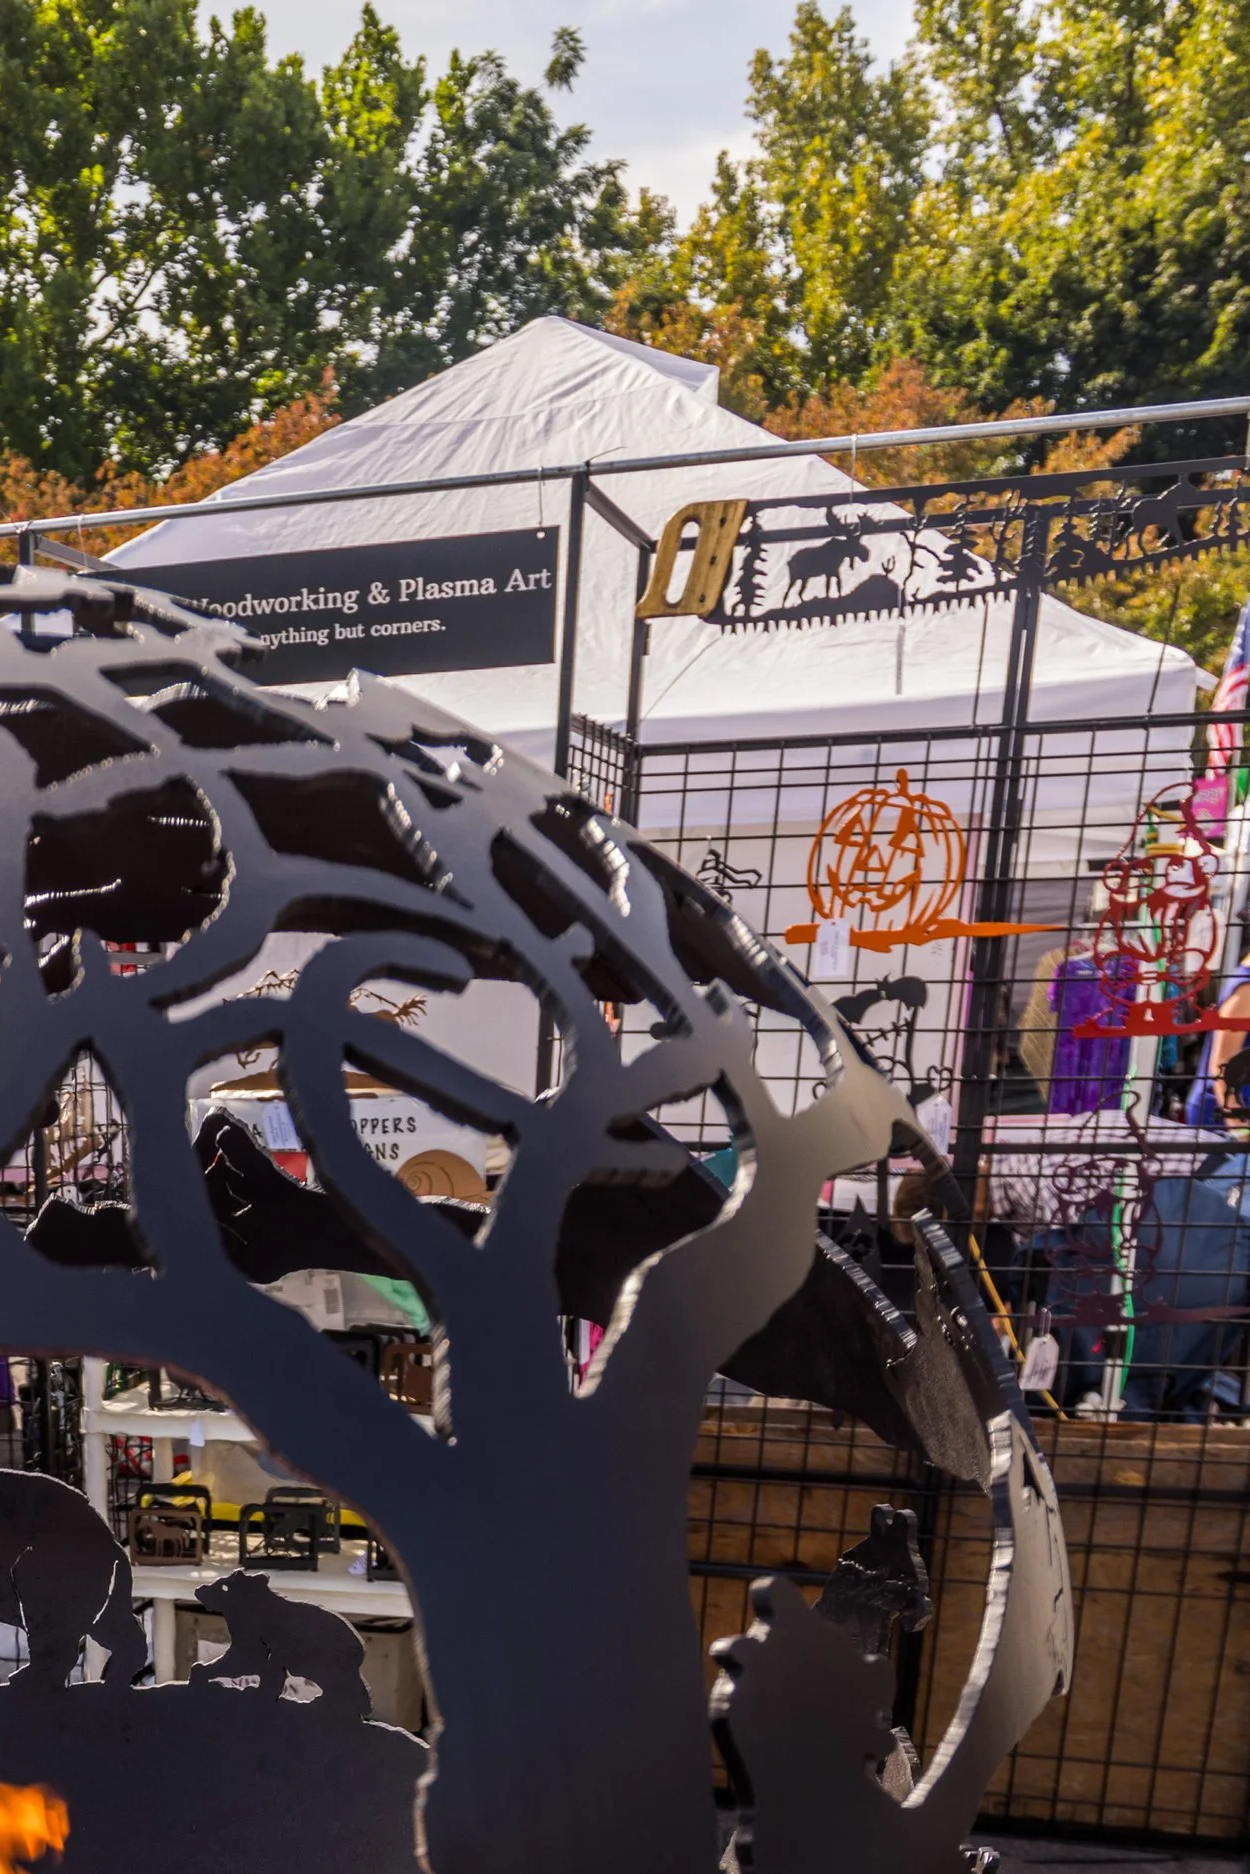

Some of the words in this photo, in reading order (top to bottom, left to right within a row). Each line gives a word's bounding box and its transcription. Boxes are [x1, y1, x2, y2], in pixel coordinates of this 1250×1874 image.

[368, 582, 391, 605] &
[399, 577, 497, 602] Plasma
[504, 568, 552, 593] Art
[260, 626, 330, 650] nything
[334, 623, 366, 640] but
[370, 619, 447, 637] corners.
[364, 1142, 400, 1161] GNS
